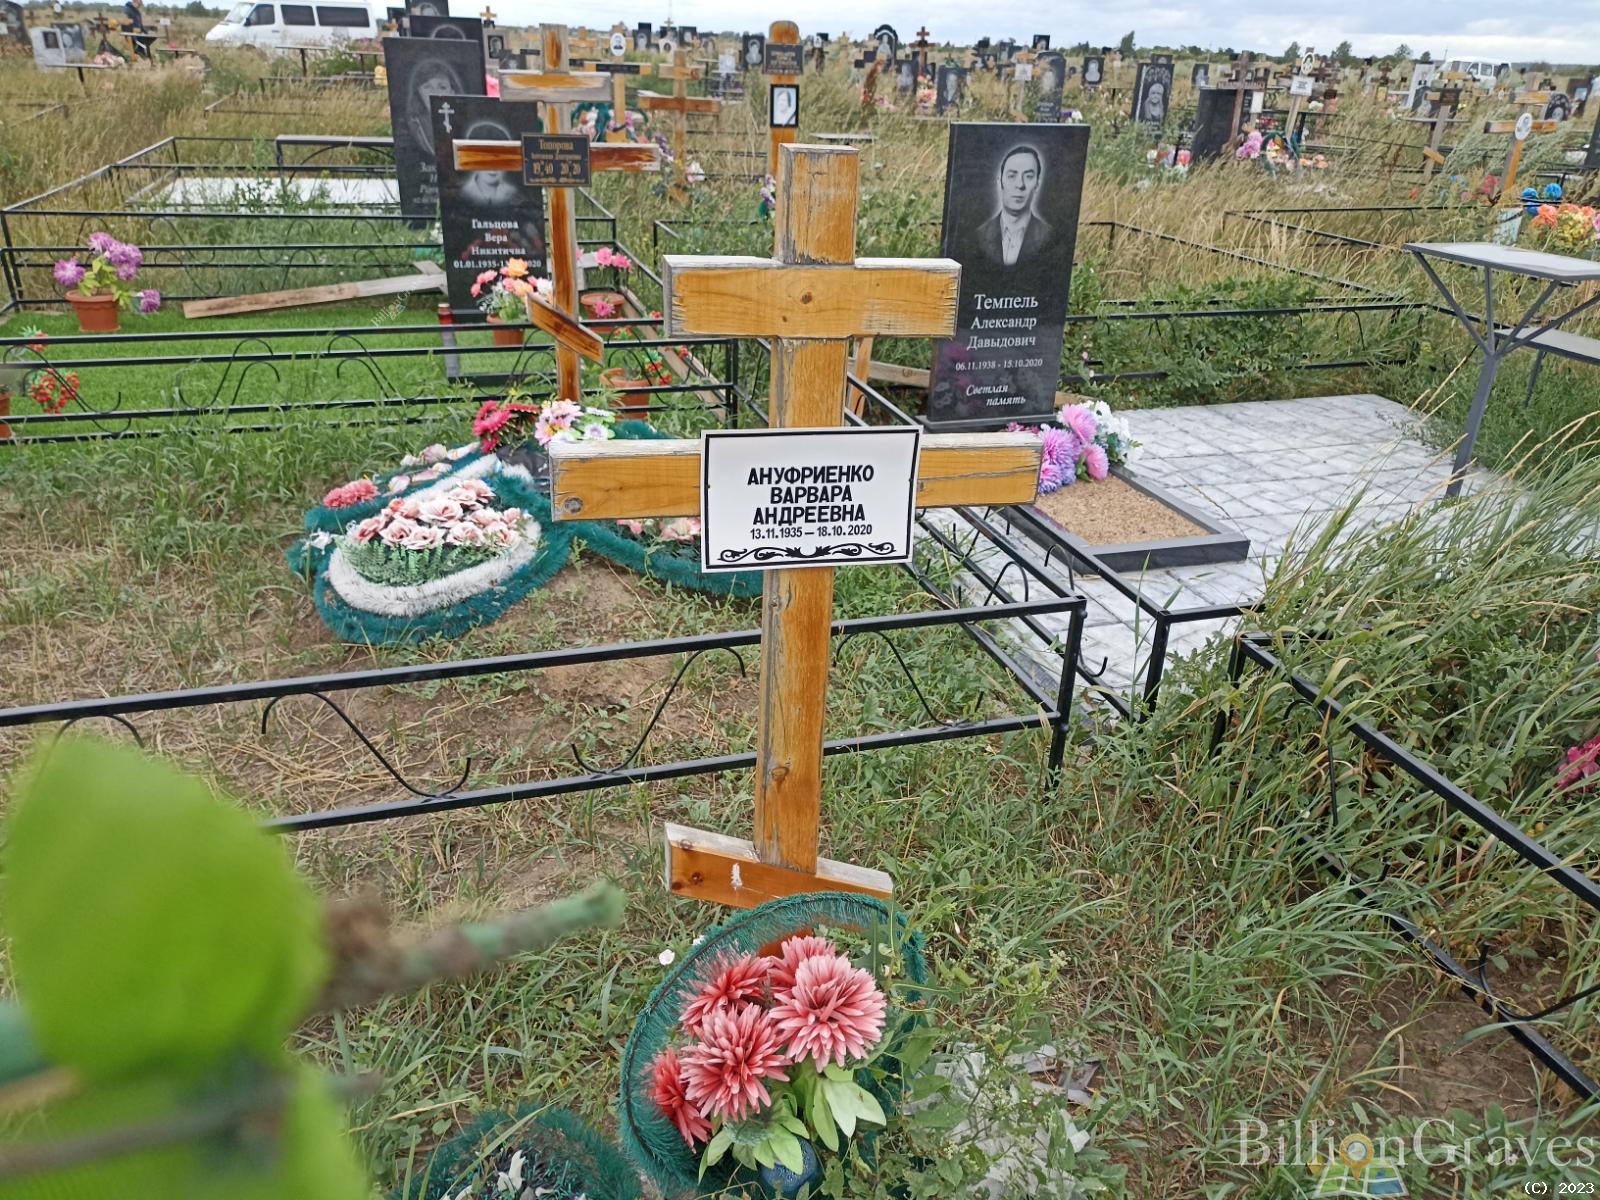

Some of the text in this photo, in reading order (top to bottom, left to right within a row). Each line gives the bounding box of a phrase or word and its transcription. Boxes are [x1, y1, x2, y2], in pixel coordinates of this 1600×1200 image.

[471, 219, 519, 230] Гальцова
[484, 232, 508, 244] Вера
[471, 246, 527, 256] Никитична
[974, 294, 1039, 310] Темпель
[970, 316, 1037, 330] Александр
[966, 336, 1037, 351] Давыдович
[955, 361, 996, 371] 06.11.1938
[1003, 358, 1043, 369] 15.10.2020
[966, 384, 1008, 396] Светлая
[986, 396, 1026, 406] память
[747, 465, 875, 485] АНУФРИЕНКО
[770, 485, 852, 504] ВАРВАРА
[752, 504, 866, 526] АНДРЕЕВНА
